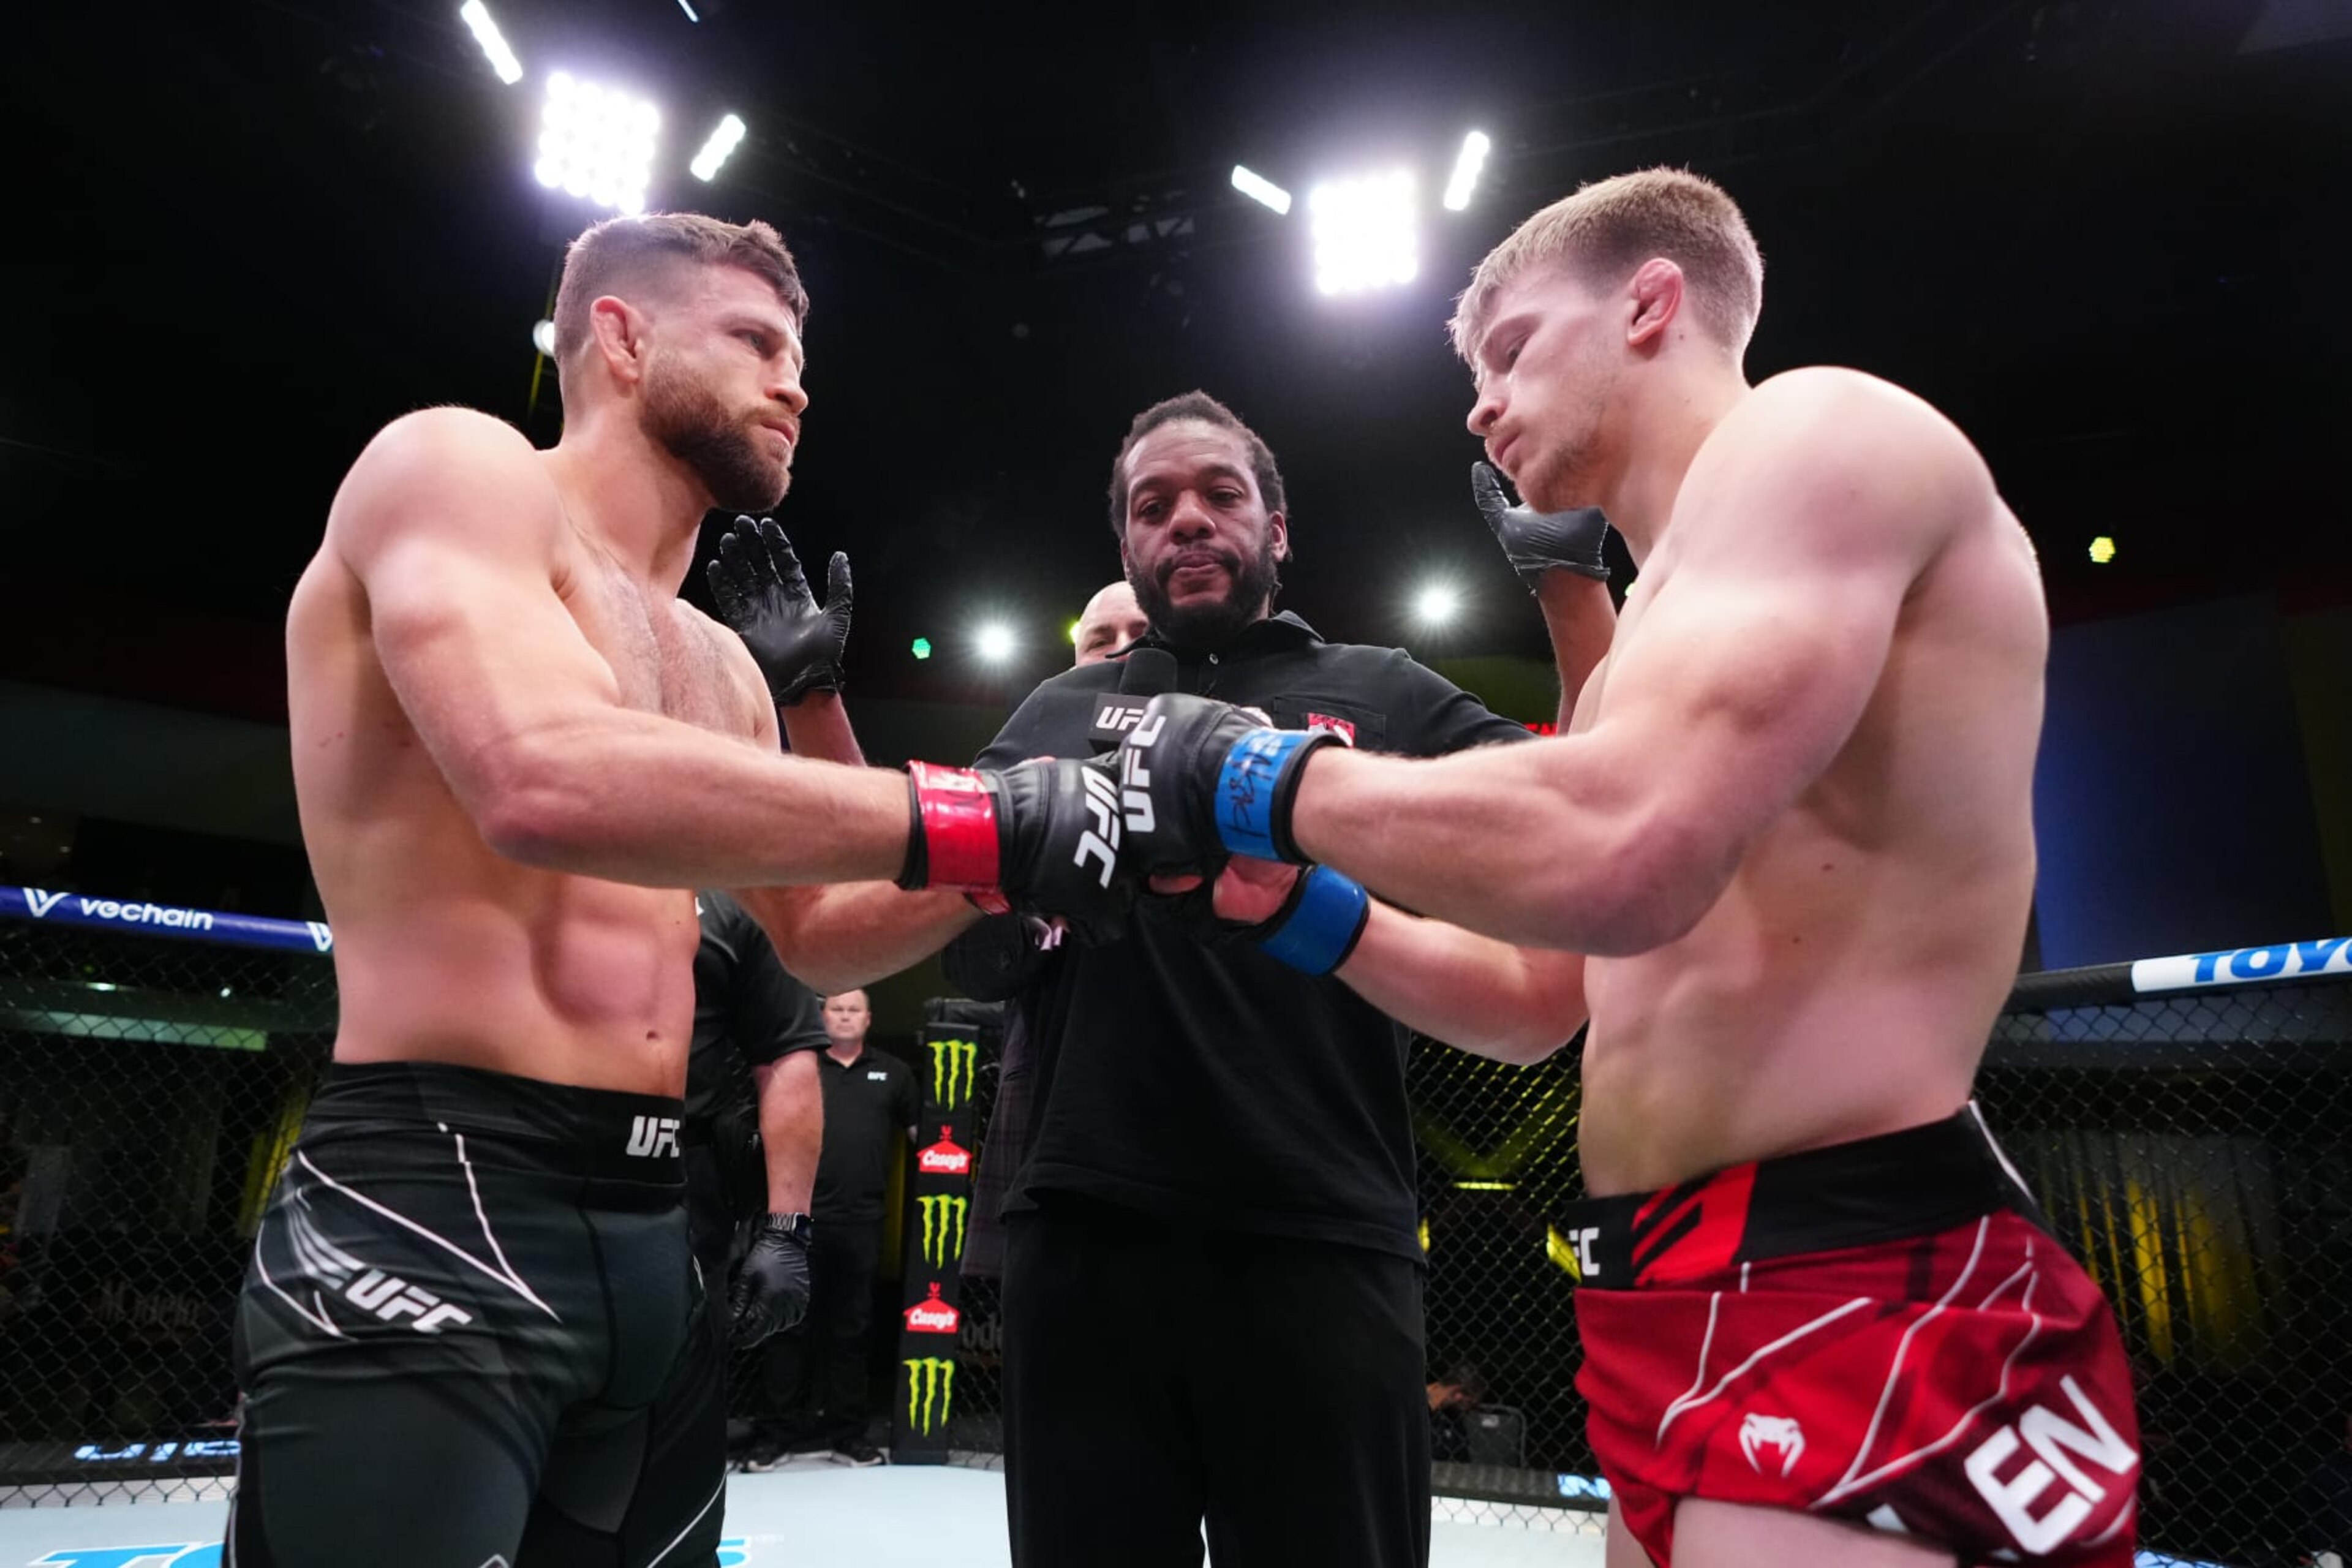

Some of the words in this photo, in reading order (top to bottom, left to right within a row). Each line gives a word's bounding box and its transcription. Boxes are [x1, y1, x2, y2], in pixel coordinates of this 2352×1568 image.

[1096, 706, 1145, 731] UF
[1123, 715, 1167, 833] UFC
[1073, 766, 1121, 889] UFC
[81, 897, 214, 930] vechain
[2192, 937, 2352, 983] TOY
[922, 1149, 968, 1171] Casey's
[345, 1268, 473, 1334] UFC
[910, 1308, 957, 1330] Casey's
[1964, 1374, 2139, 1556] EN
